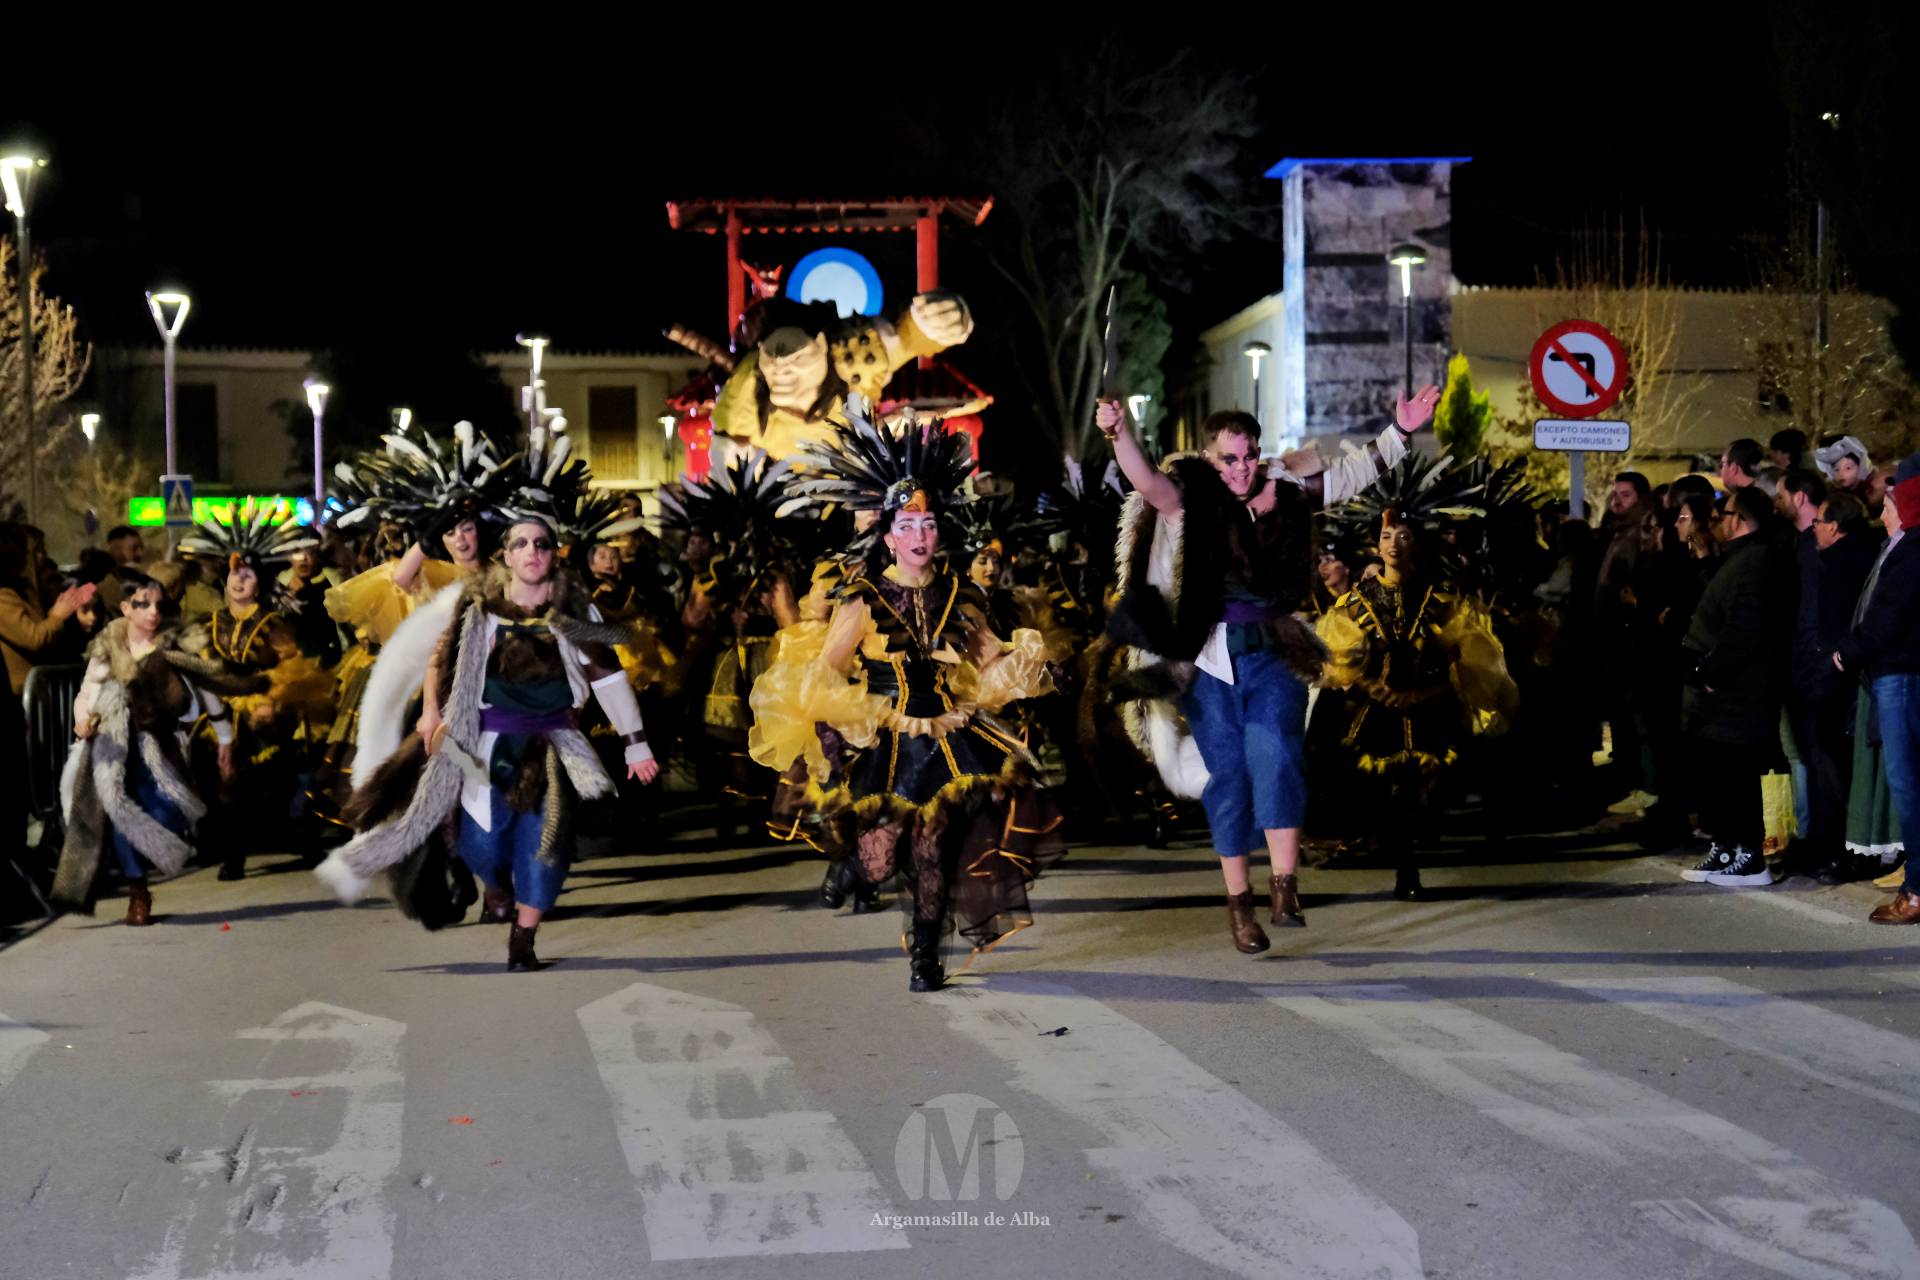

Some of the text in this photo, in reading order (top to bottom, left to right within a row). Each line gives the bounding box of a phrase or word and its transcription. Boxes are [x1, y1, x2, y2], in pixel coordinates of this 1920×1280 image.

[1537, 426, 1627, 435] EXCEPTO CAMIONES
[1559, 437, 1613, 445] AUTOBUSES
